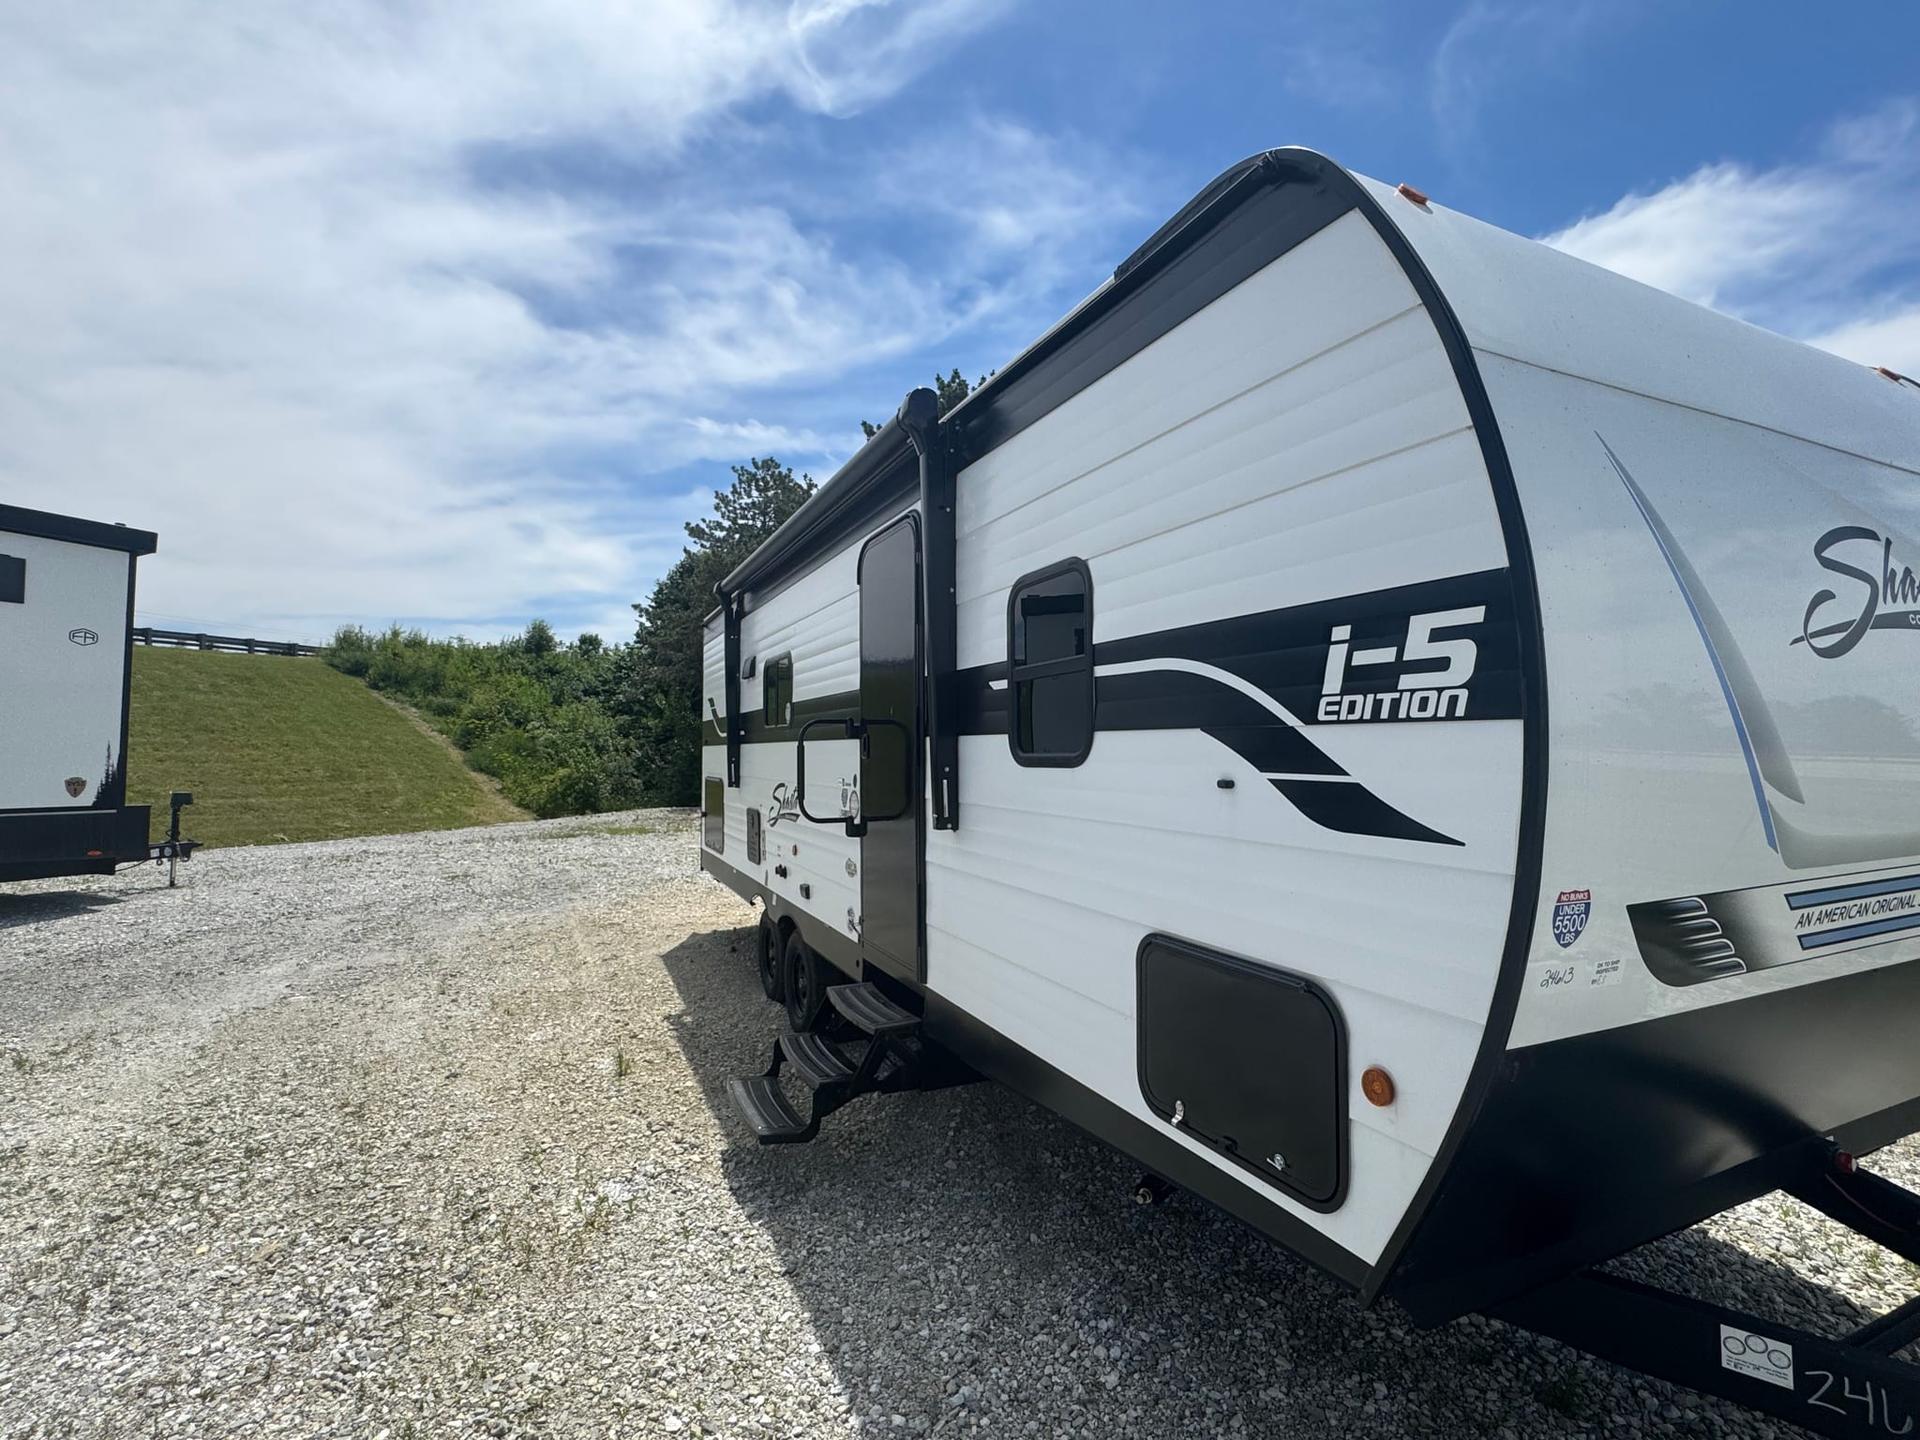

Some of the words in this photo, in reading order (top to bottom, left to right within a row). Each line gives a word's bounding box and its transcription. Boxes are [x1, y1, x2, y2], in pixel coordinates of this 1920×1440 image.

[1803, 525, 1920, 659] Sha
[1321, 605, 1487, 695] i-5
[1317, 688, 1469, 721] EDITION
[1554, 914, 1585, 933] 5500
[1559, 904, 1585, 915] UNDER
[1794, 910, 1815, 930] AN
[1813, 901, 1872, 926] AMERICAN
[1871, 894, 1917, 915] ORIGINAL
[1560, 933, 1575, 943] LBS
